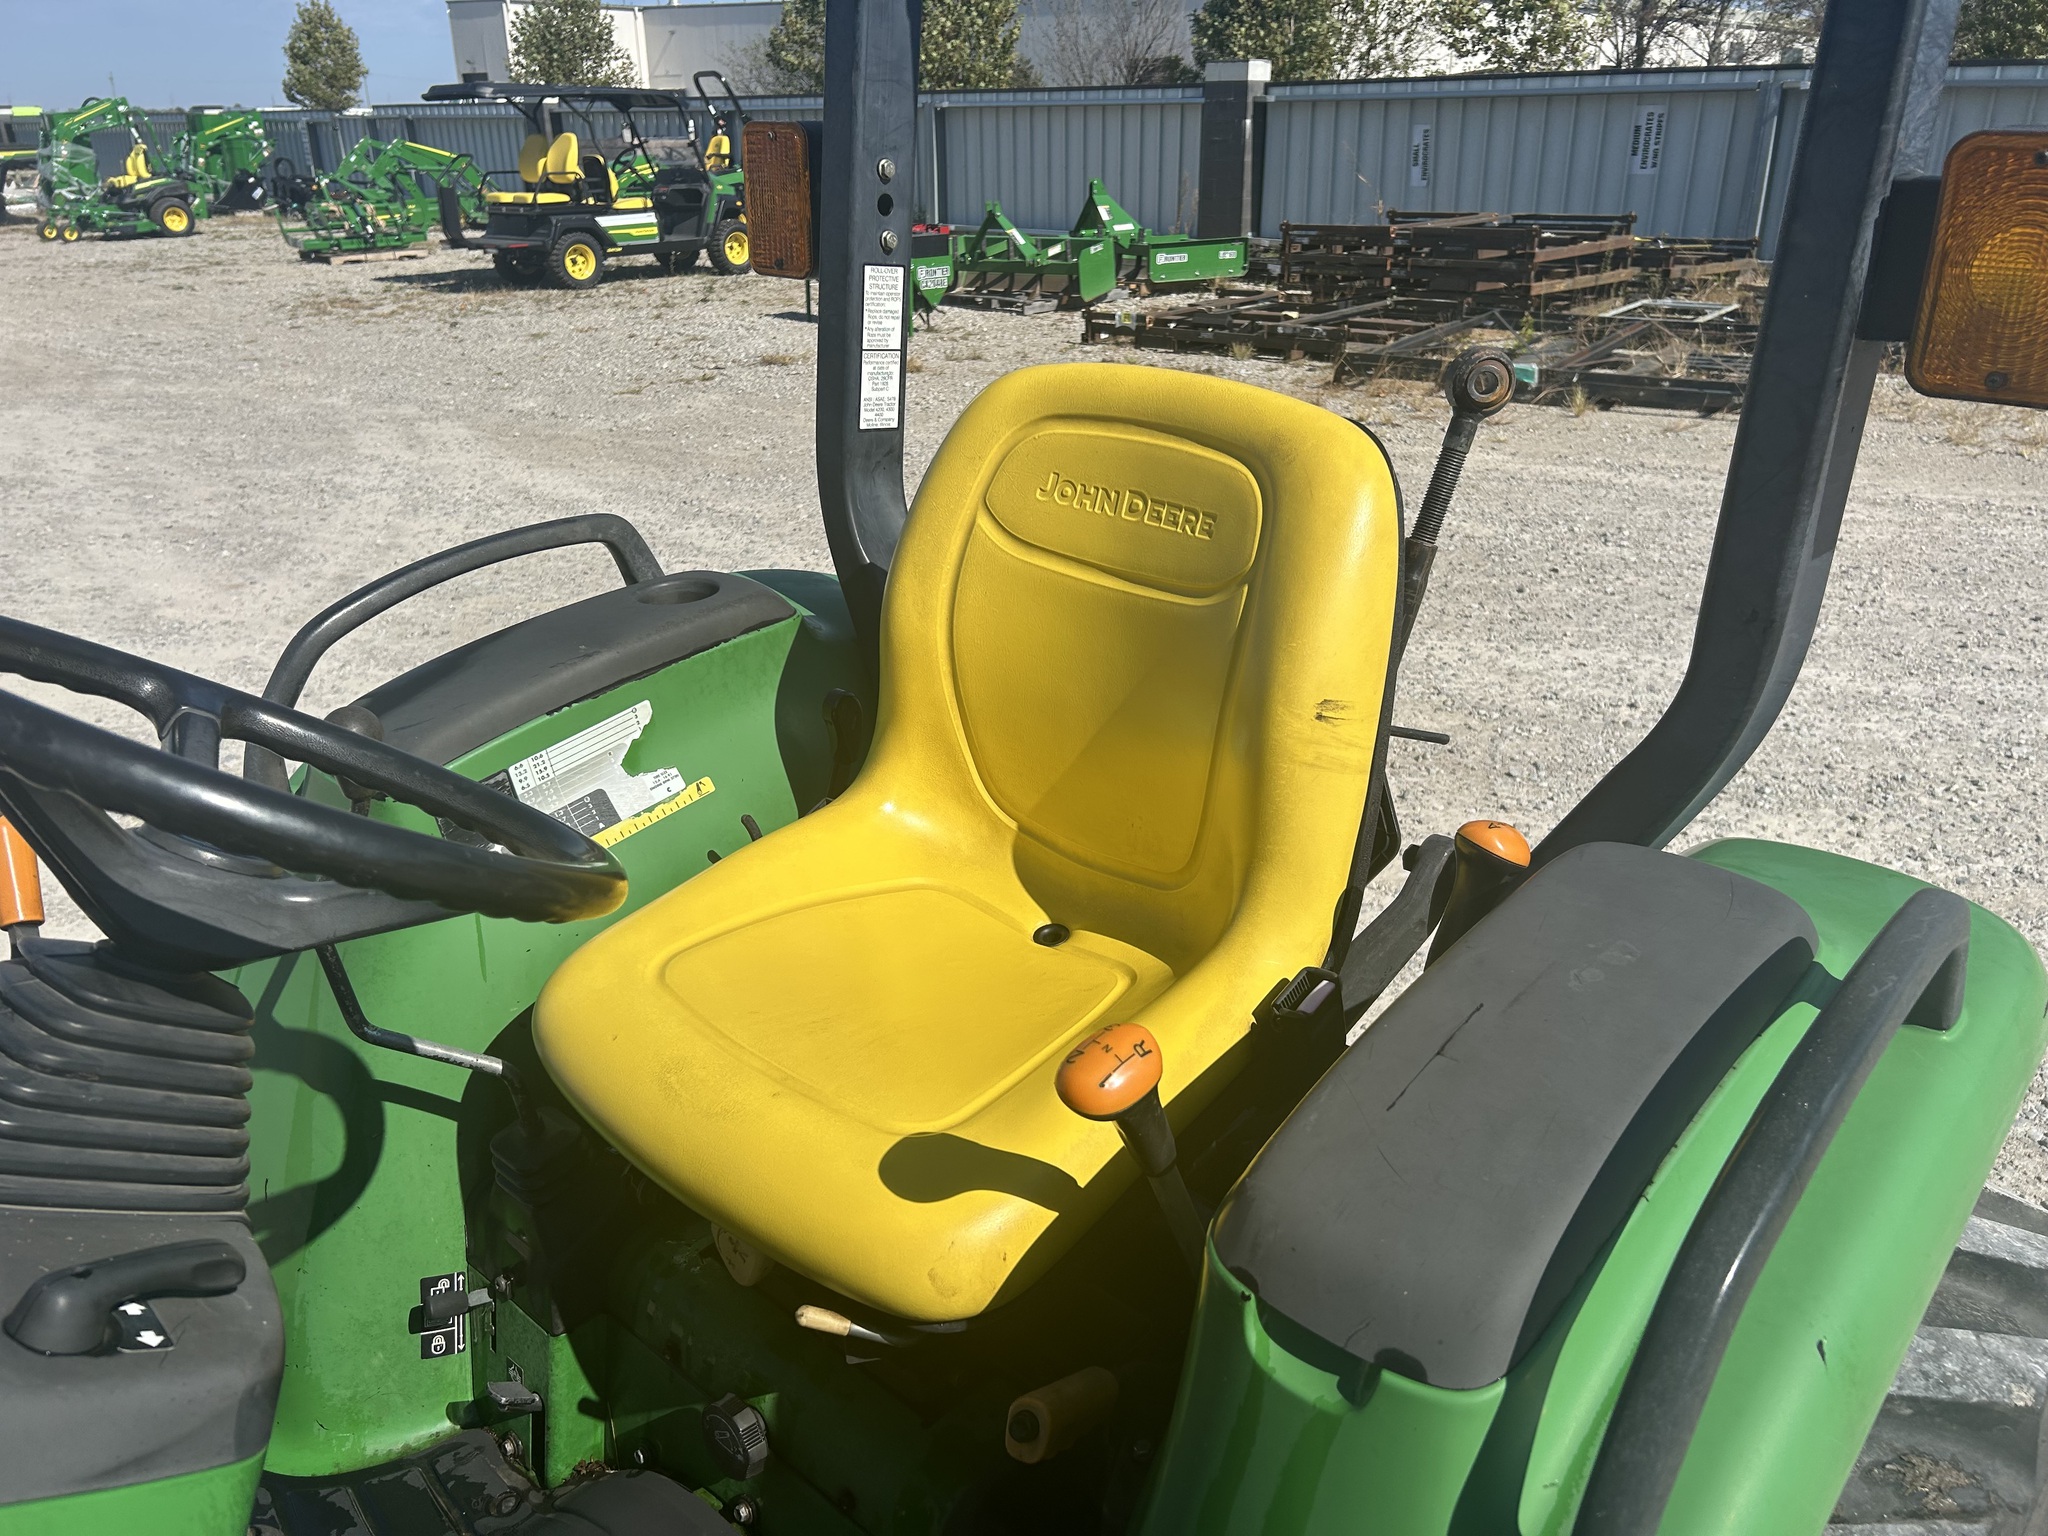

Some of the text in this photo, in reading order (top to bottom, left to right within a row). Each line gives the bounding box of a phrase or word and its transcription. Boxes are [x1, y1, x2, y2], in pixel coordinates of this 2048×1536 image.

[1421, 129, 1430, 180] ENVIROCRATES
[1631, 125, 1642, 156] MEDIUM
[1640, 112, 1654, 169] ENVIROCRATES
[869, 283, 899, 291] STRUCTURE
[1036, 471, 1218, 540] JOHN DEERE
[1133, 1039, 1153, 1058] R
